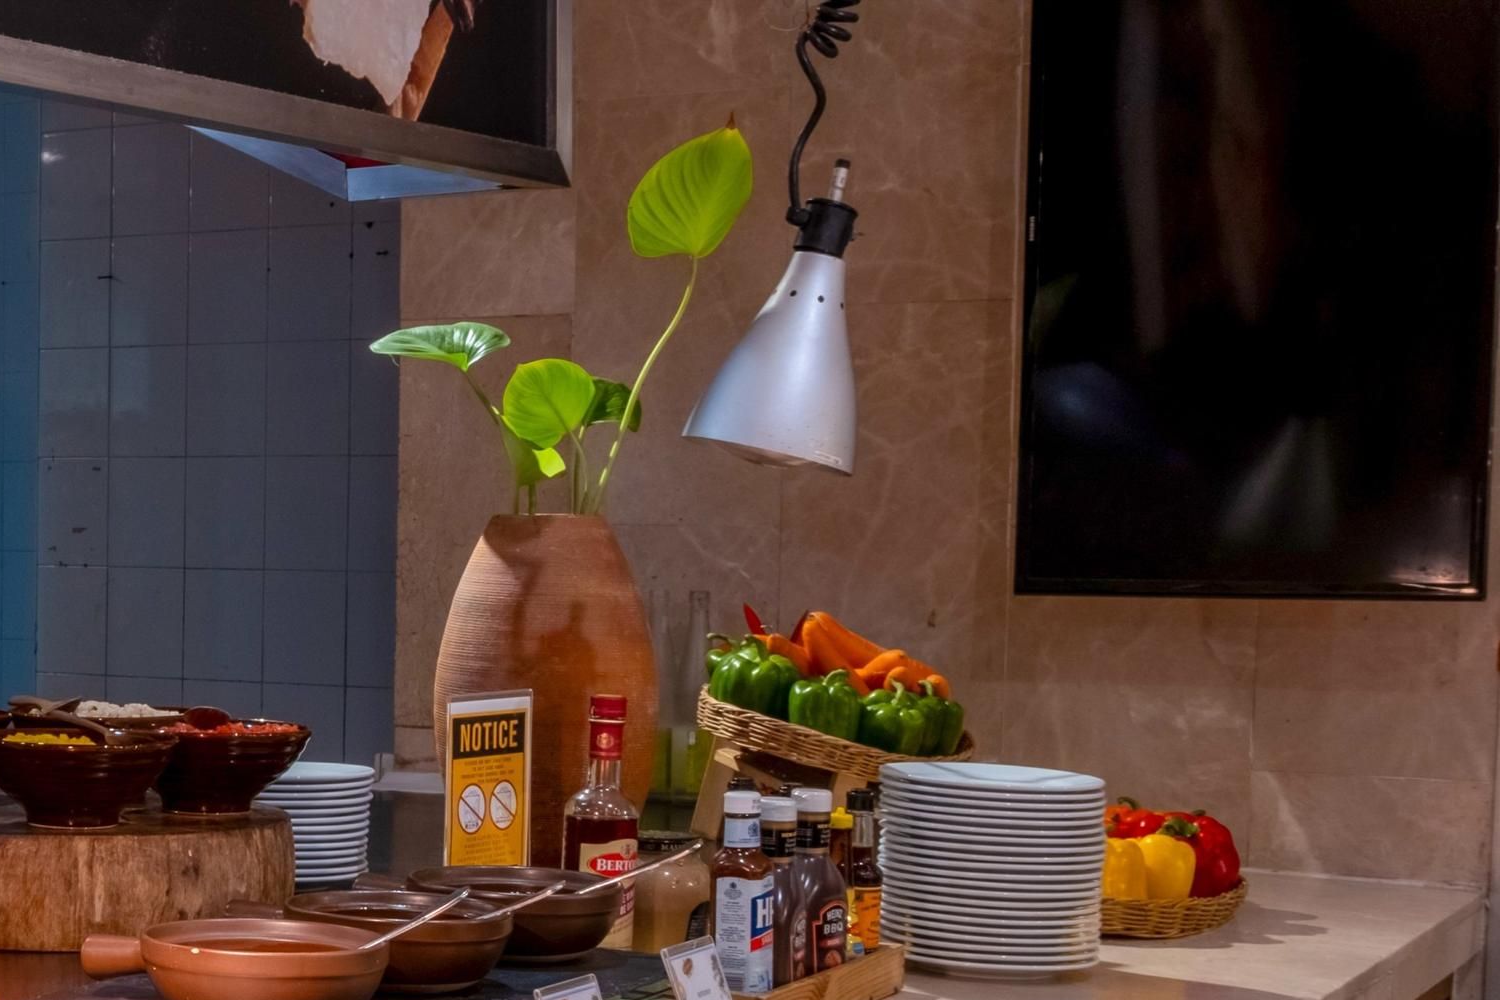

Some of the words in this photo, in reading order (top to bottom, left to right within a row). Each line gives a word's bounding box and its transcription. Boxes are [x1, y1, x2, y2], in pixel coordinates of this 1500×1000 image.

[460, 719, 518, 752] NOTICE
[826, 908, 843, 920] HEINZ
[824, 924, 843, 935] BBQ
